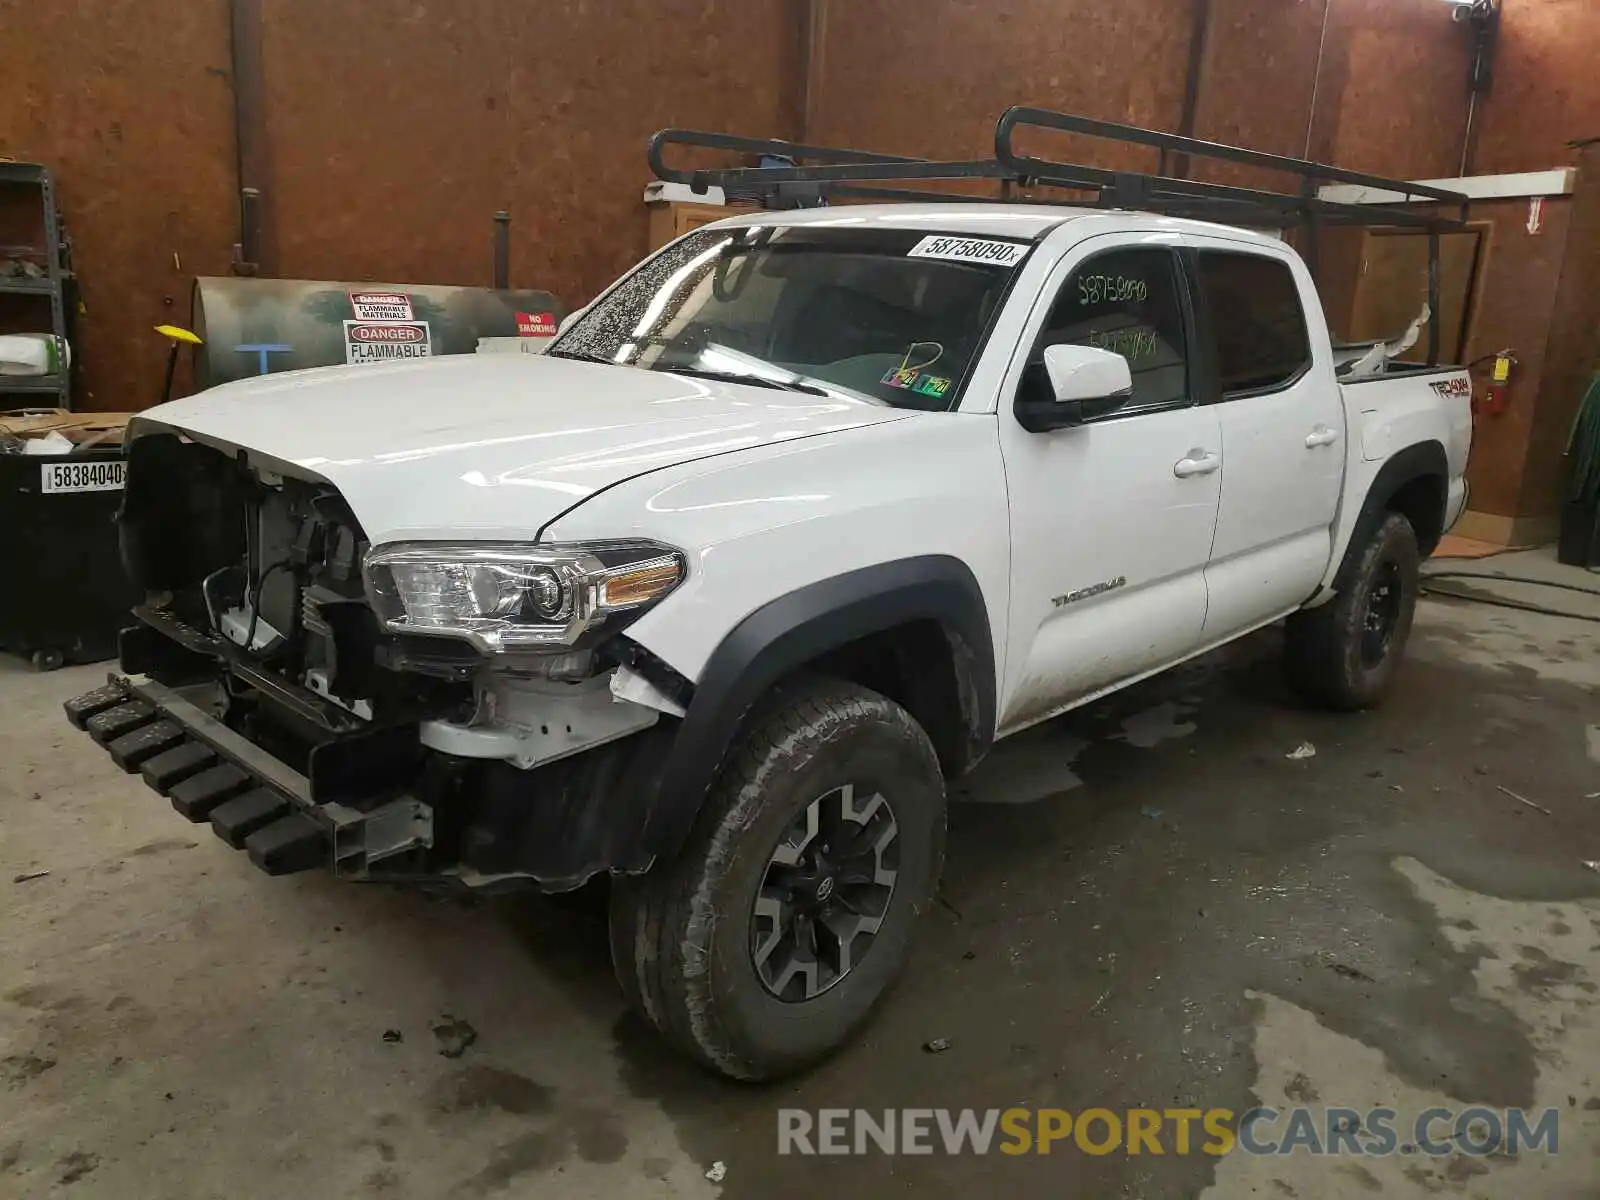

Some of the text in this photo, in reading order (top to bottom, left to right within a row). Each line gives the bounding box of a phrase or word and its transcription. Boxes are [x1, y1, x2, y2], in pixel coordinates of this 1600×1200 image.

[359, 295, 403, 303] DANGER
[362, 311, 406, 319] MATERIALS
[528, 314, 542, 323] NO
[518, 323, 557, 333] SMOKING
[360, 328, 415, 339] DANGER
[351, 344, 427, 358] FLAMMABLE
